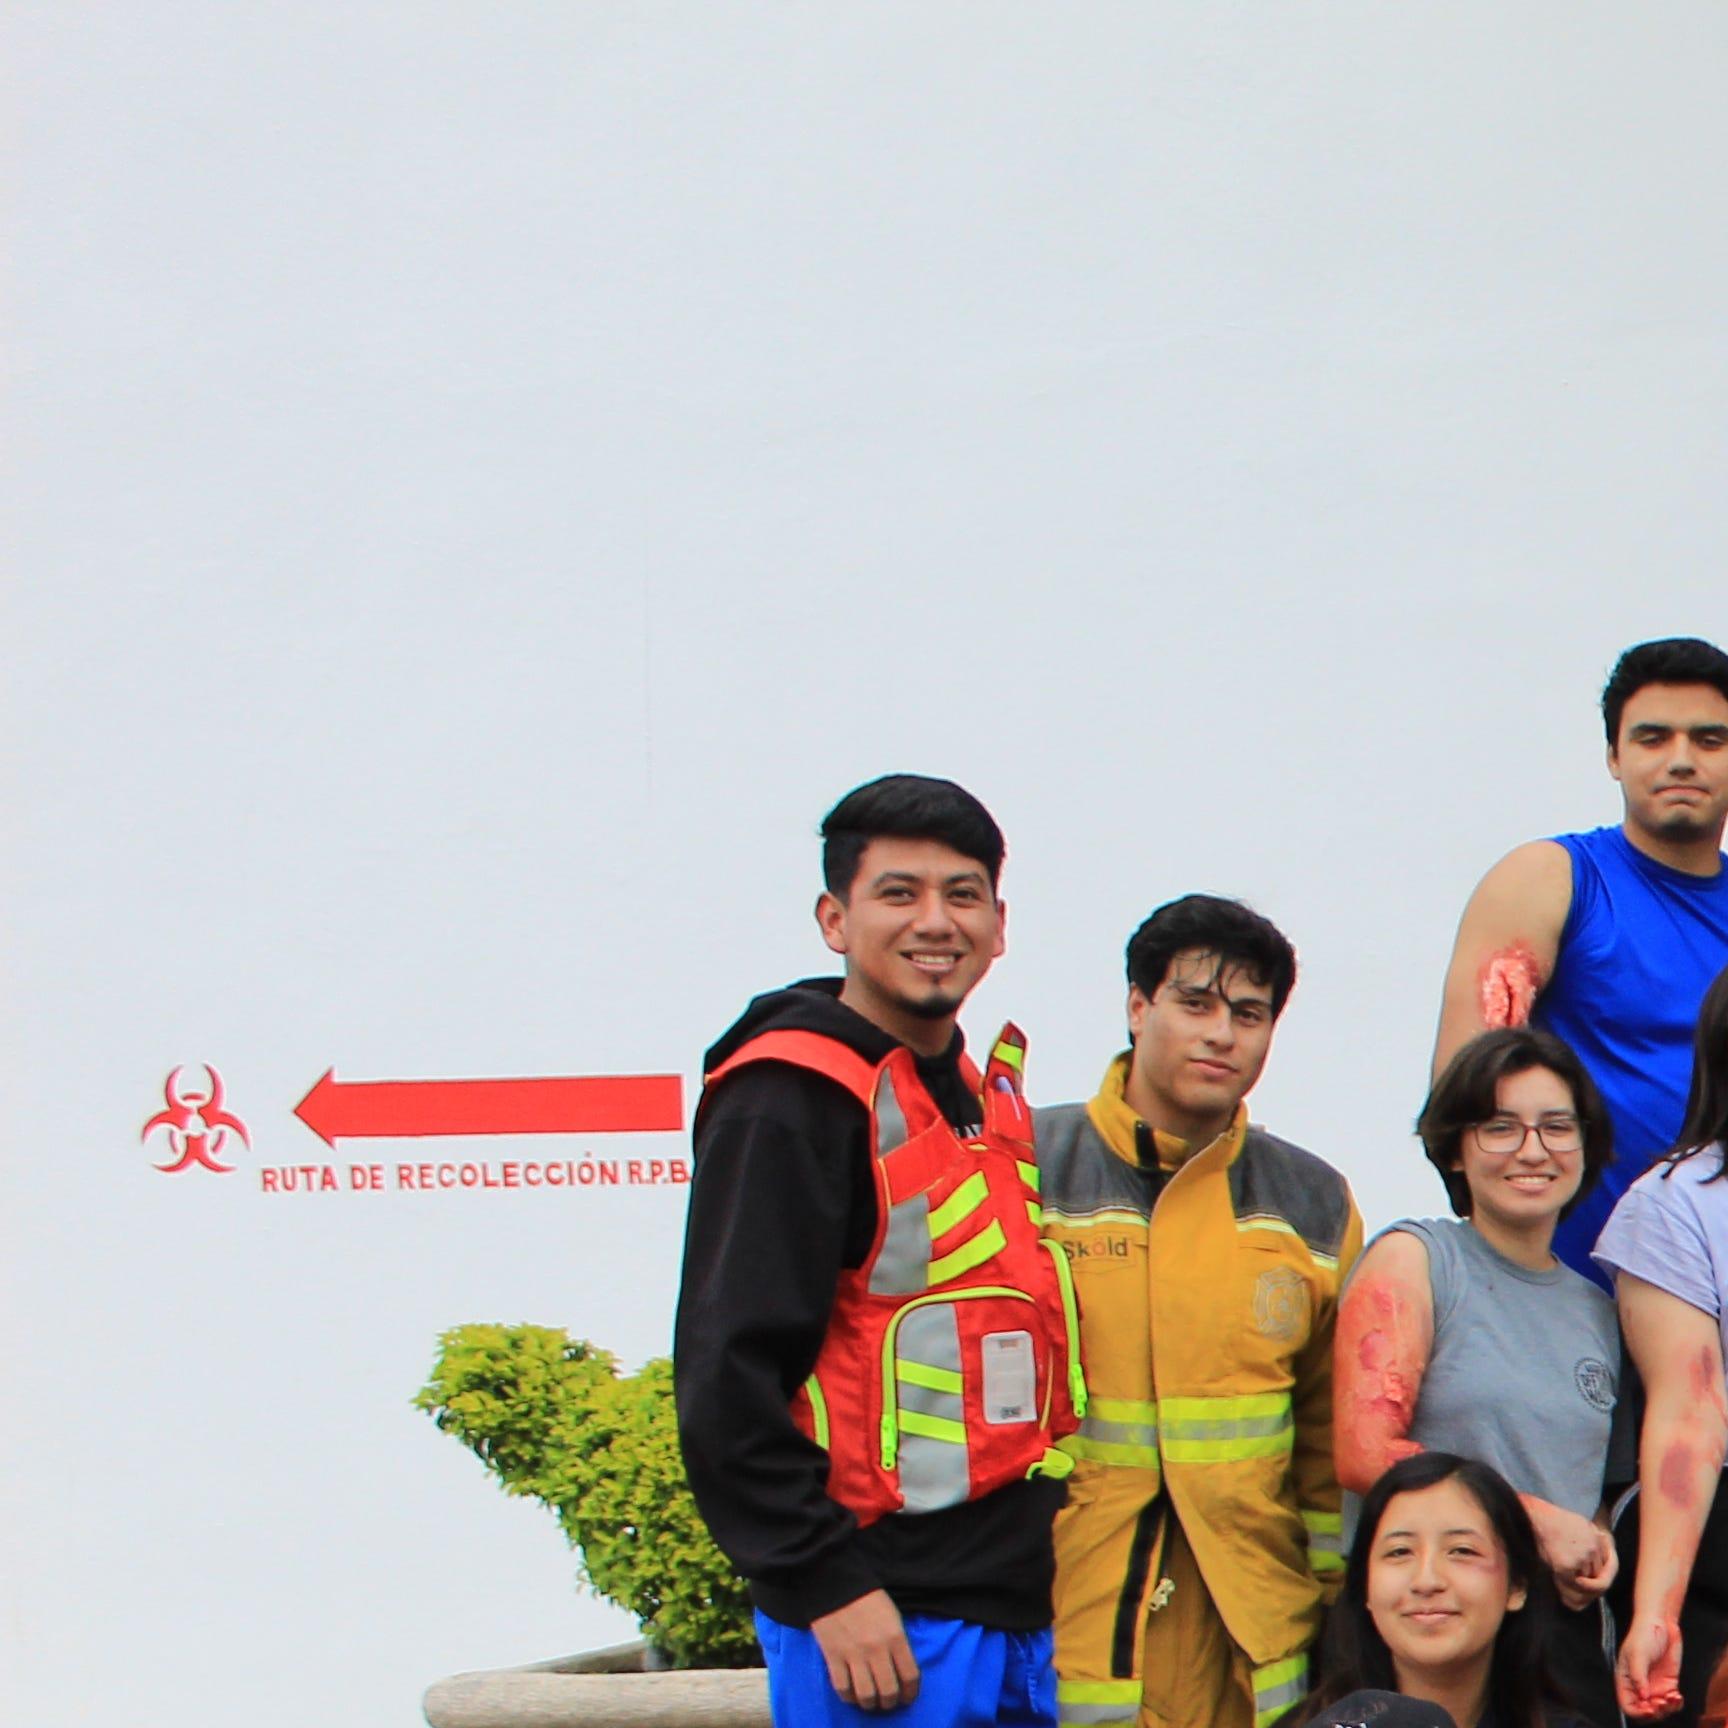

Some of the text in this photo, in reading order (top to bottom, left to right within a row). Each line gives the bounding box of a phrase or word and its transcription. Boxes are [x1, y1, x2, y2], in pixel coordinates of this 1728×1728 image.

[261, 1165, 339, 1192] RUTA
[350, 1164, 385, 1191] DE
[397, 1151, 620, 1190] RECOLECCIÓN
